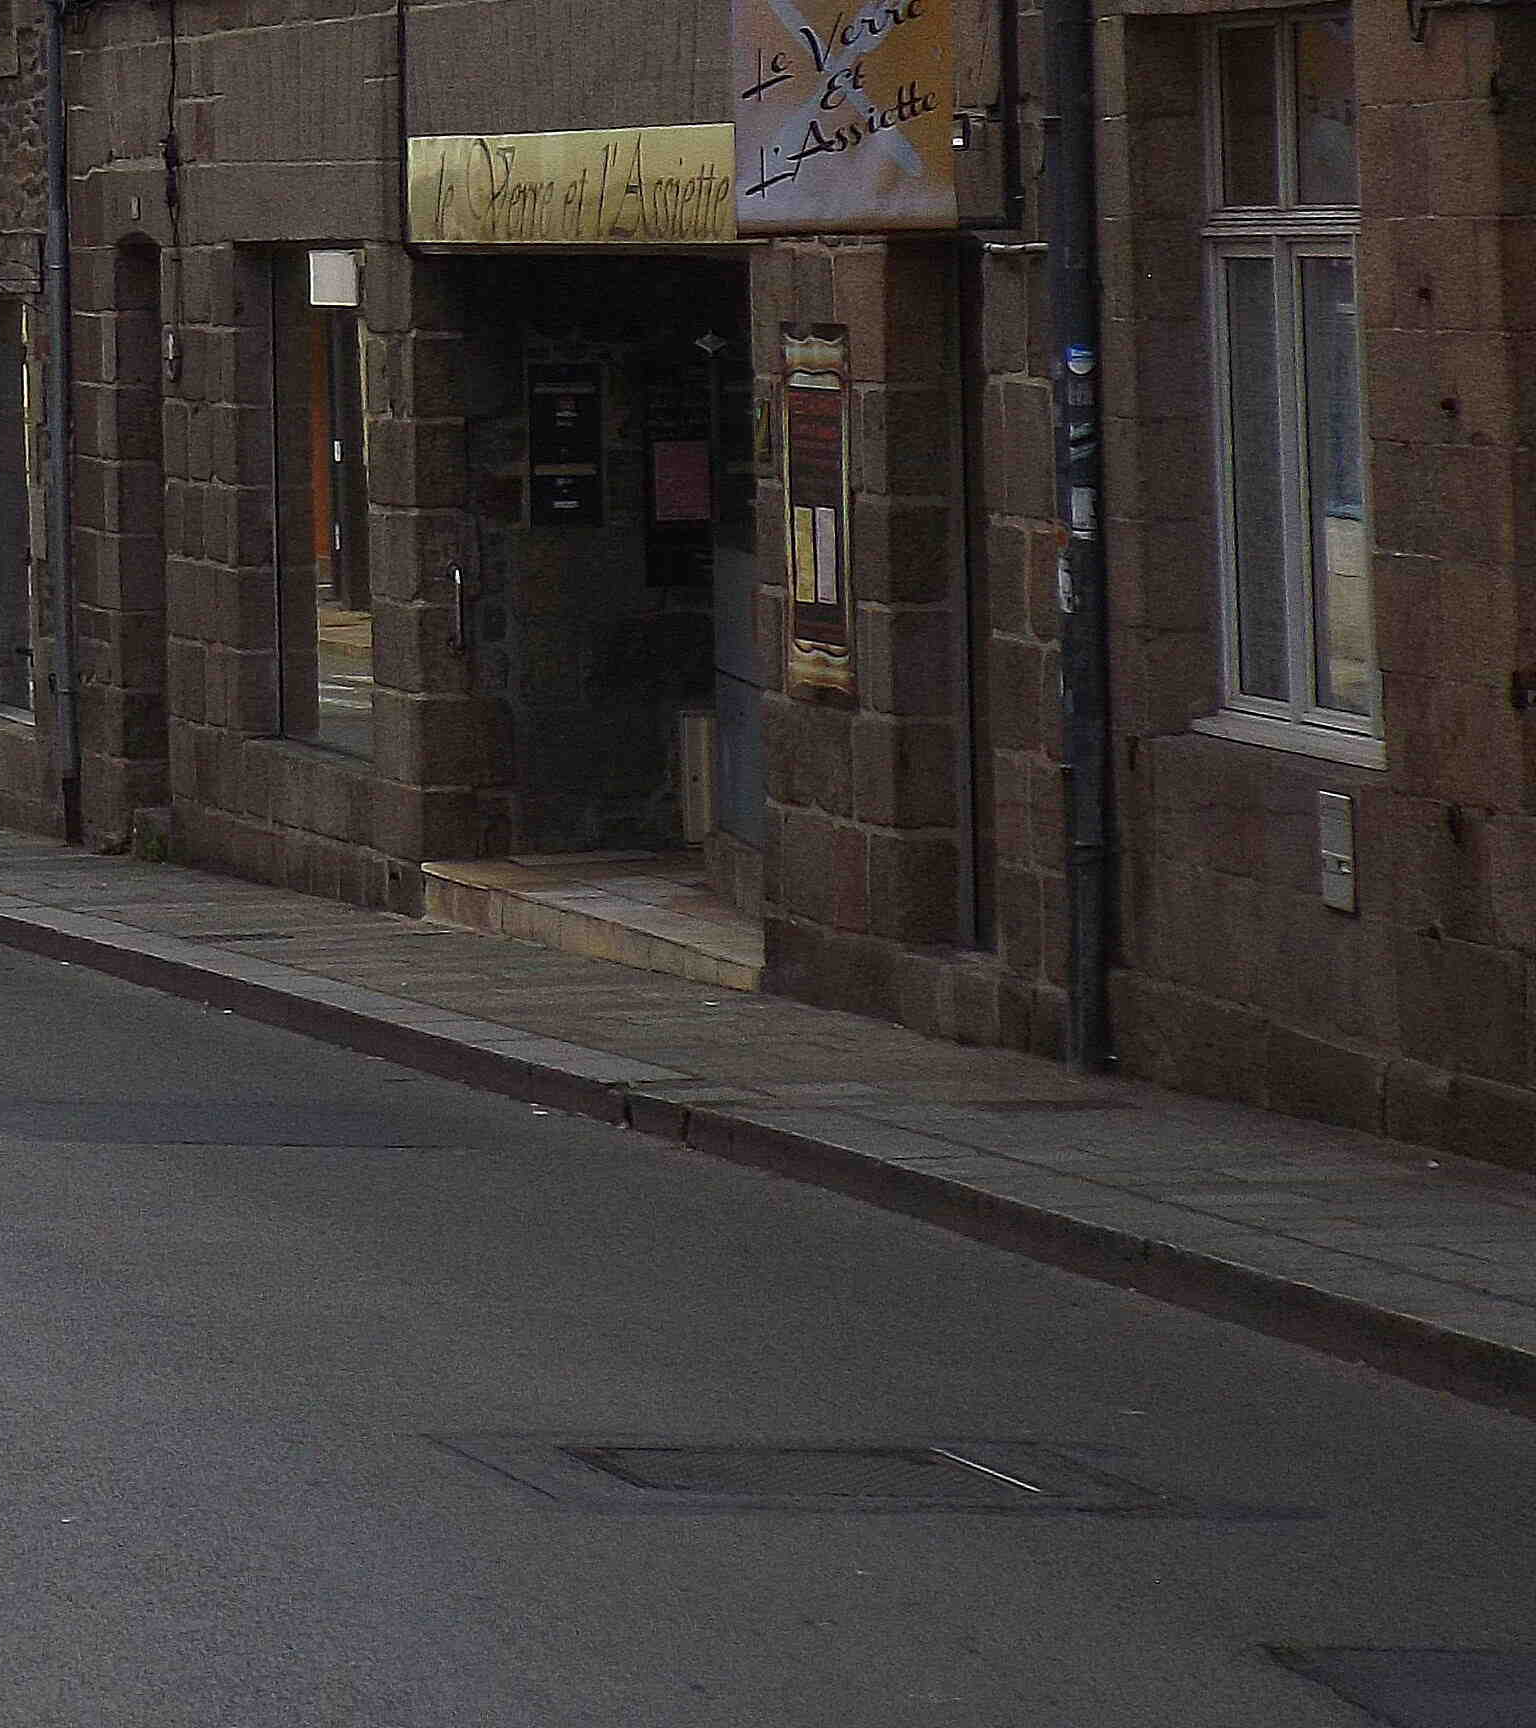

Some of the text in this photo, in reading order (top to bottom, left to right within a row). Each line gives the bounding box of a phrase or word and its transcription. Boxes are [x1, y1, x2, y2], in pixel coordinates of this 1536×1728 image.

[742, 47, 795, 101] Le
[820, 60, 865, 110] Et
[745, 80, 938, 199] L'Assiette
